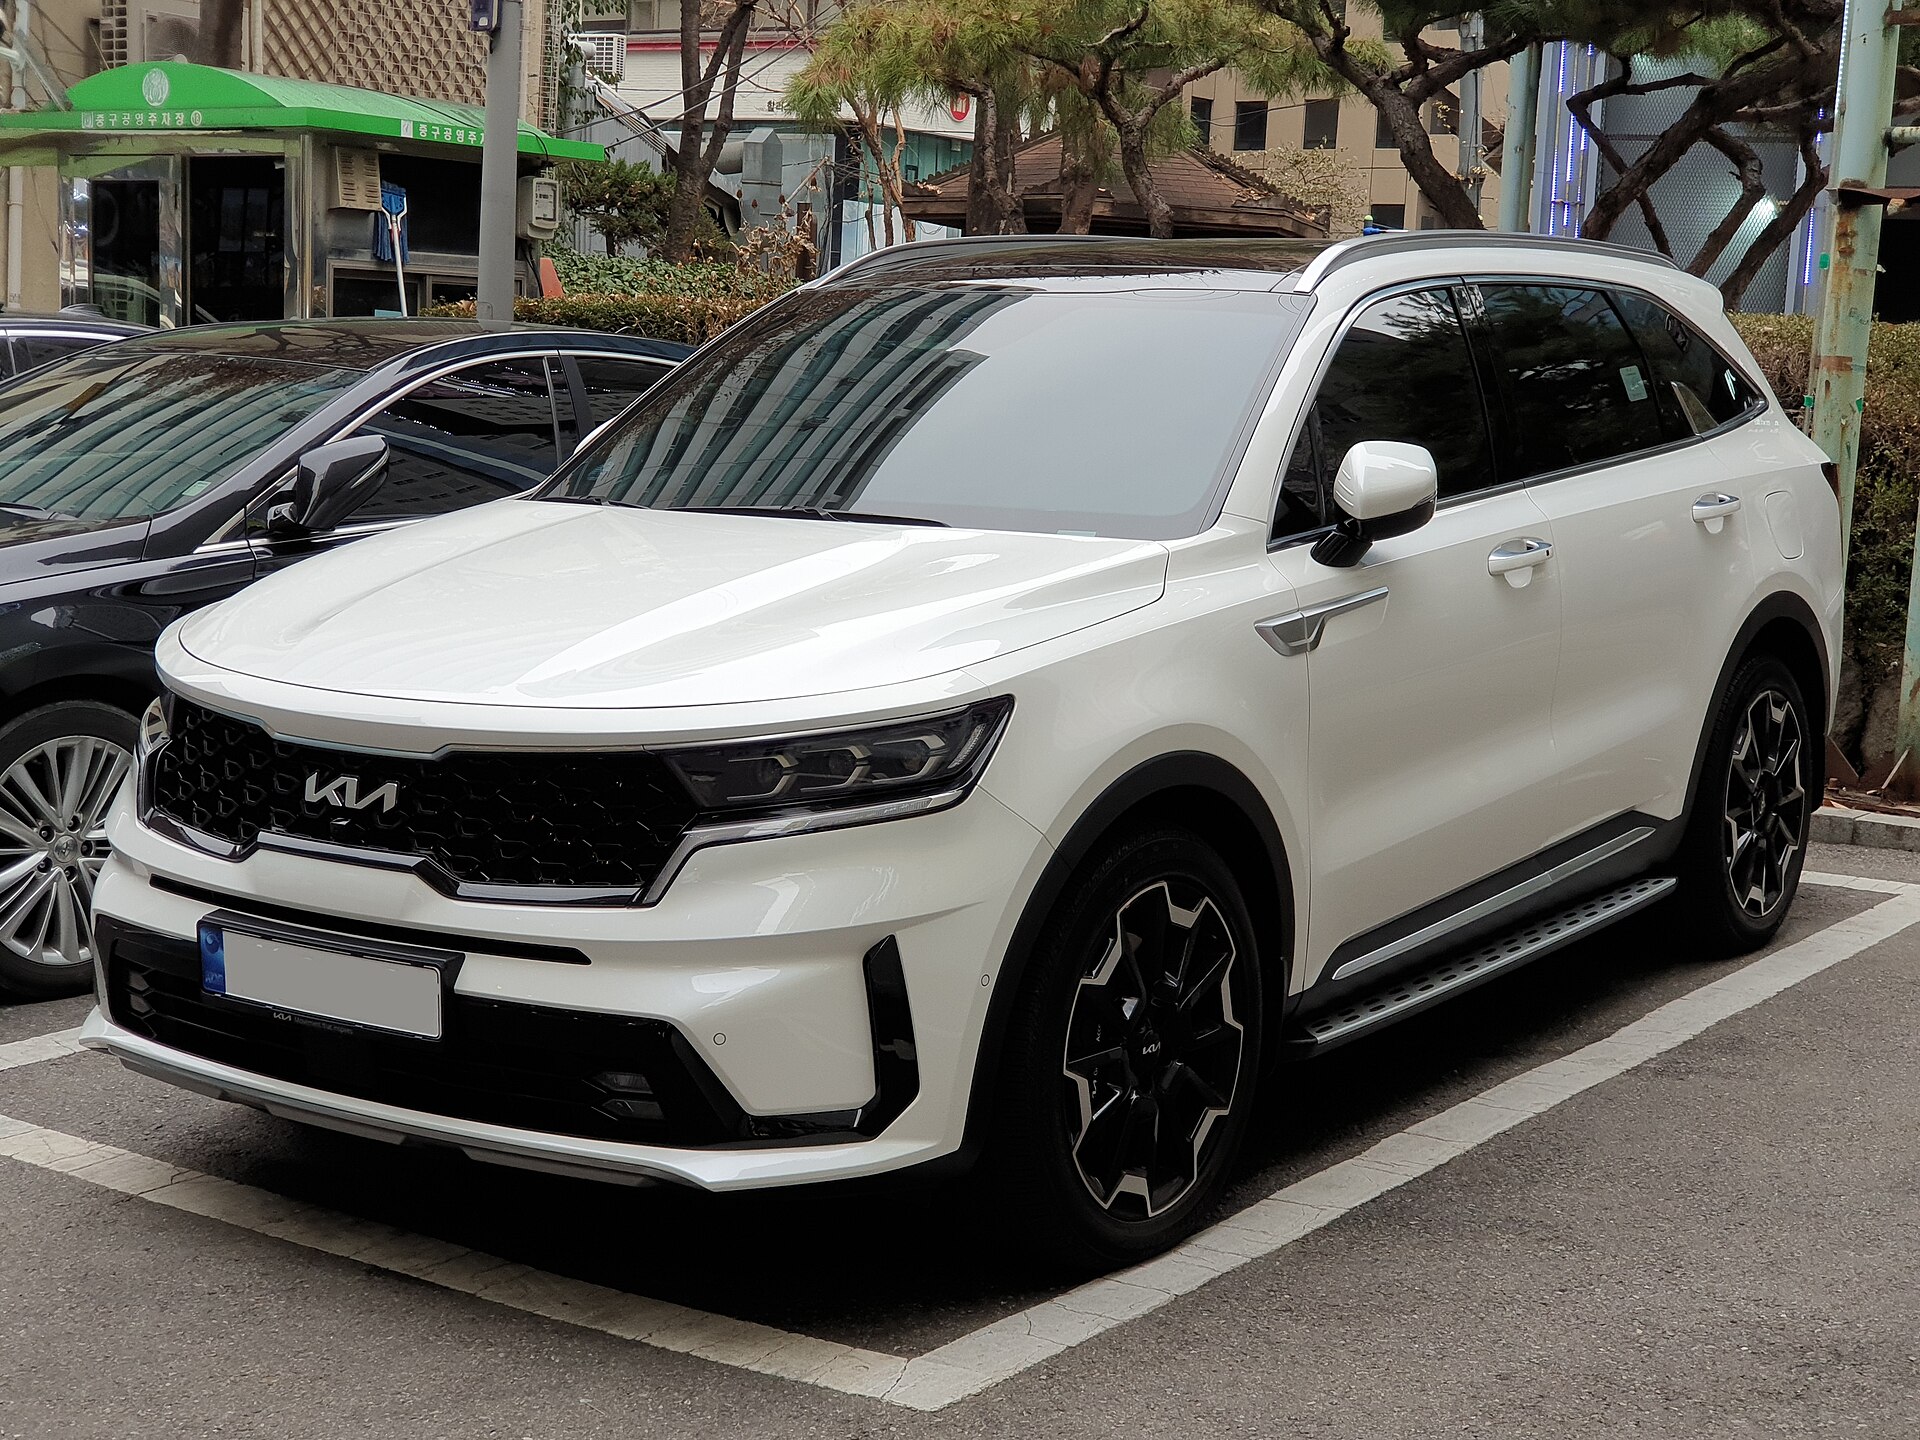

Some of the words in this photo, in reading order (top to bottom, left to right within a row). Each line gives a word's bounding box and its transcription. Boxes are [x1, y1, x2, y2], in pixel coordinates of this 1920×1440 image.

[95, 112, 185, 126] 중구공영주차장
[305, 772, 397, 813] KIA
[273, 1012, 292, 1021] KIA
[1142, 1041, 1161, 1054] KIA
